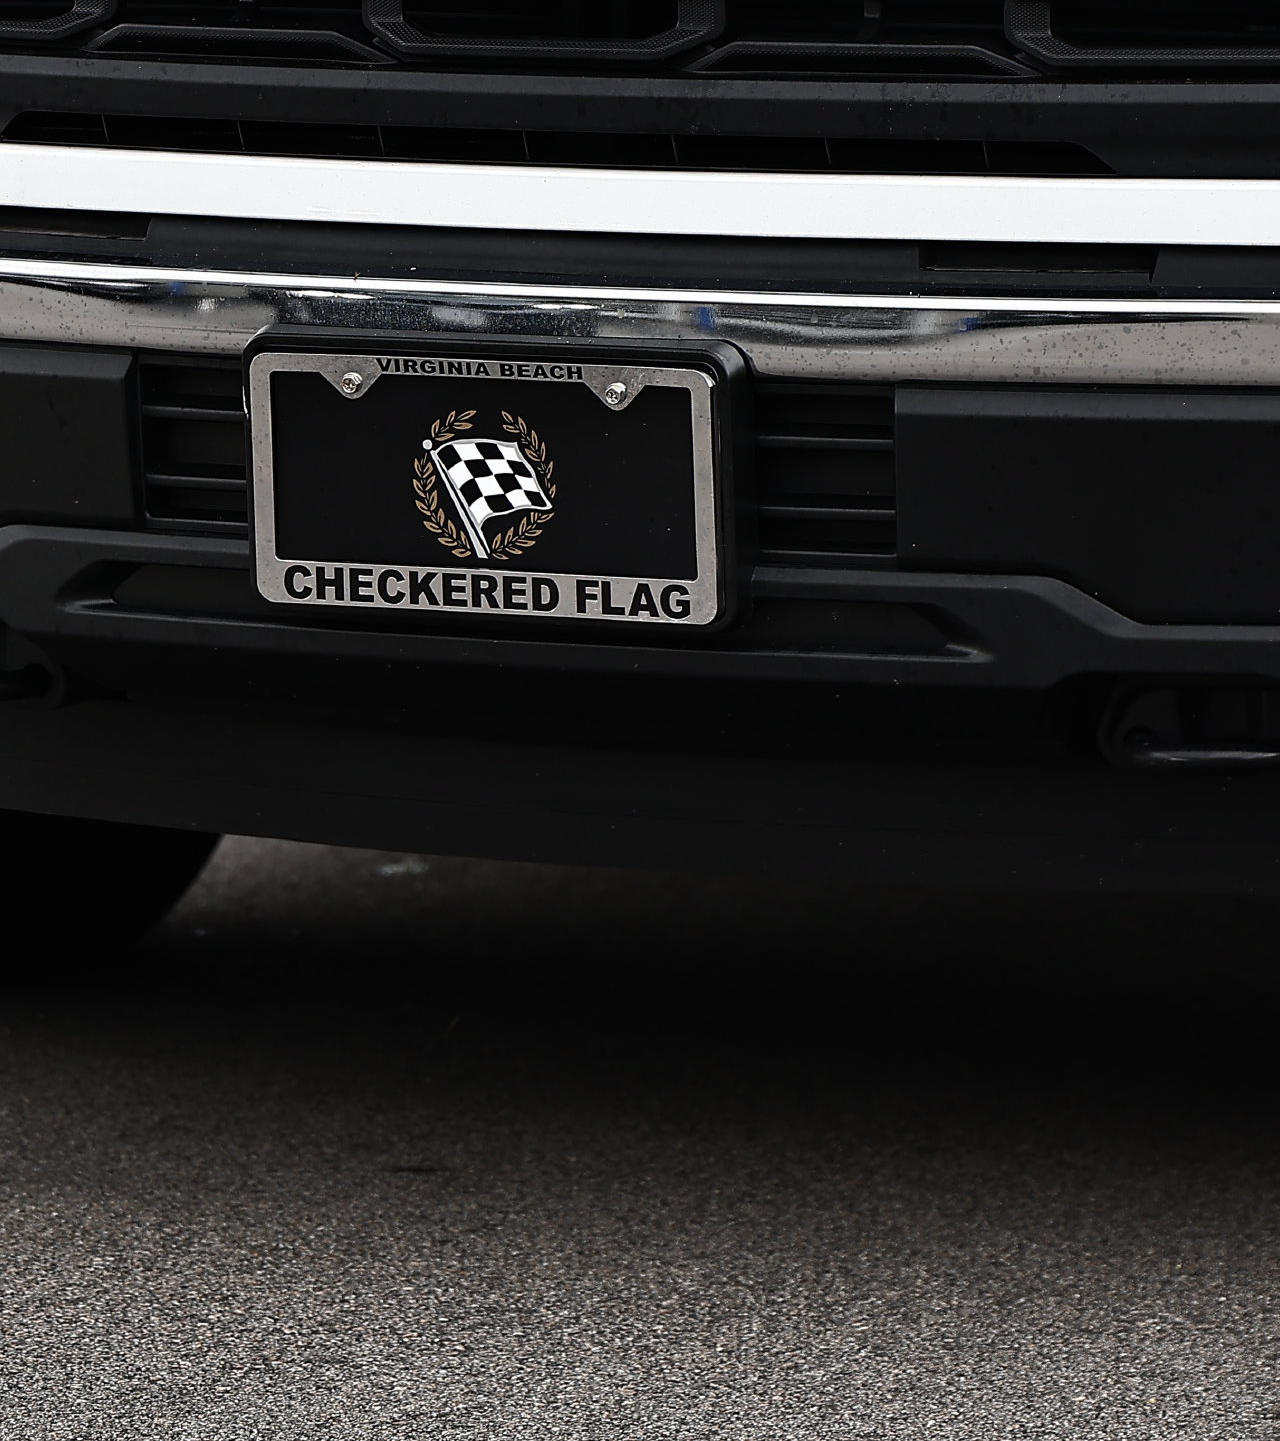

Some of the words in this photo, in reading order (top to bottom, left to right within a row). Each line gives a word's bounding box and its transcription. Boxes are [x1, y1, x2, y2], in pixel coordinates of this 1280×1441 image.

[376, 358, 491, 377] VIRGINIA
[499, 363, 584, 381] BEACH
[283, 564, 560, 612] CHECKERED
[575, 579, 691, 620] FLAG
